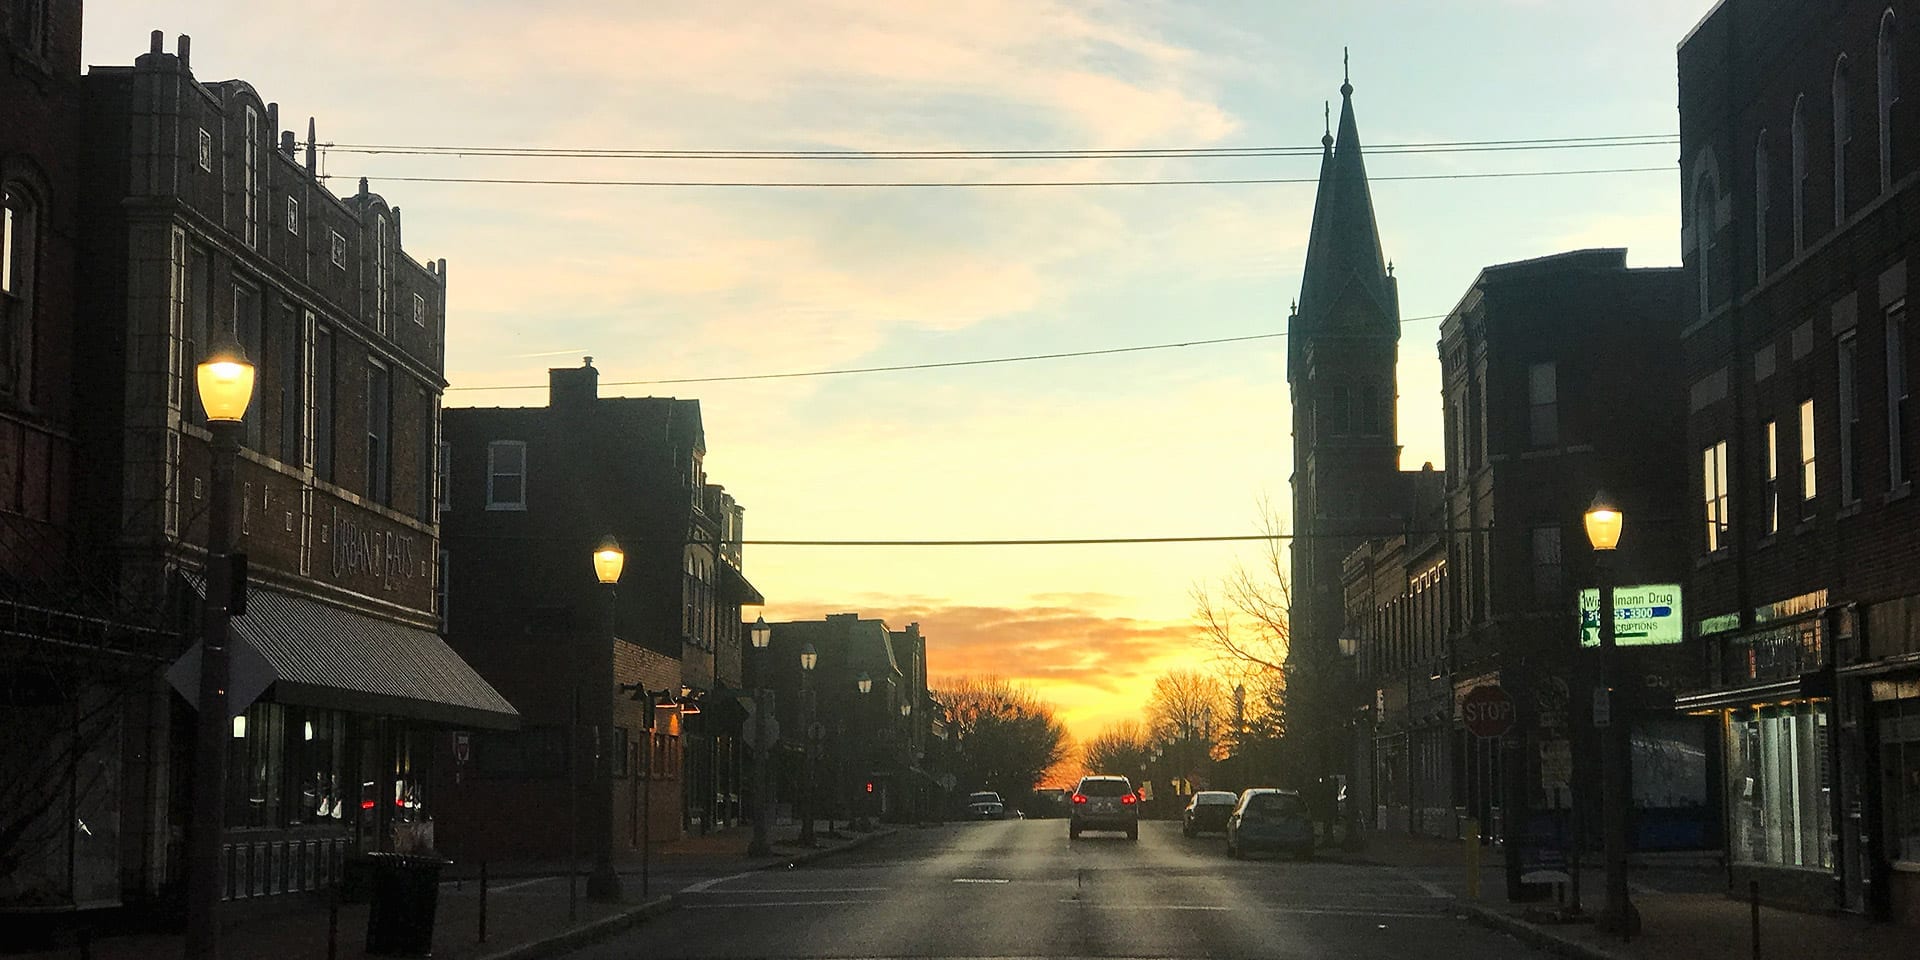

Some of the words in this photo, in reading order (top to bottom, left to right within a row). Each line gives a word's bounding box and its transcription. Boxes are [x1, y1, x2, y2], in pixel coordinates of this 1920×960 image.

[333, 506, 373, 577] URBAN
[384, 531, 413, 590] EATS
[1648, 592, 1673, 604] Drug
[1467, 702, 1510, 721] STOP
